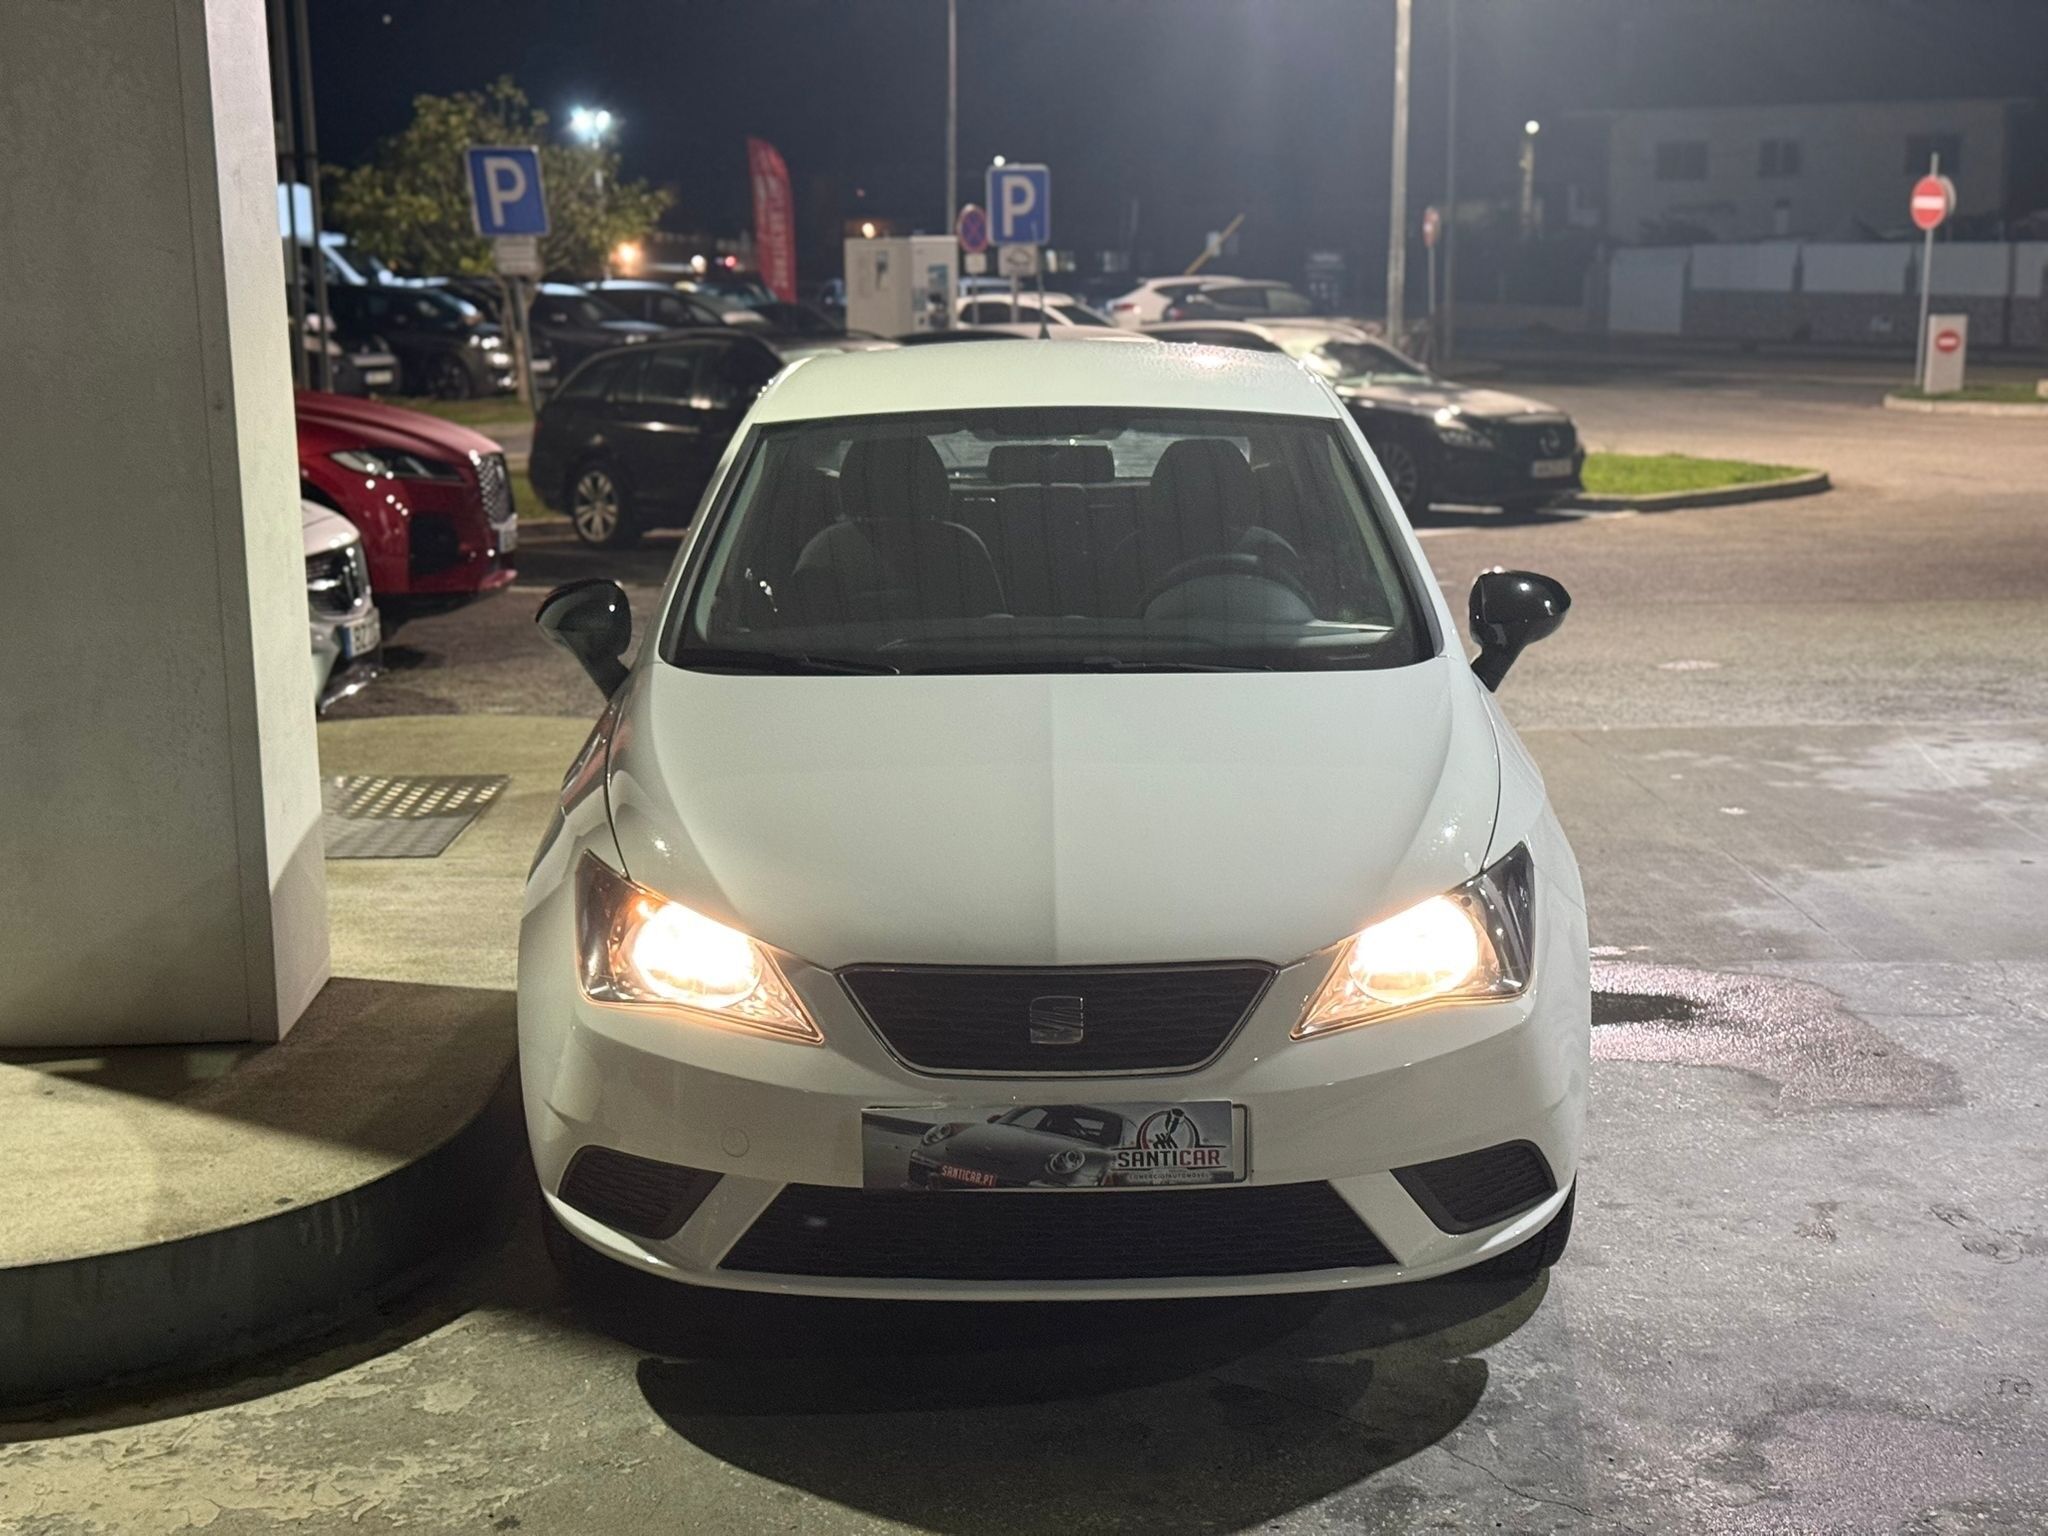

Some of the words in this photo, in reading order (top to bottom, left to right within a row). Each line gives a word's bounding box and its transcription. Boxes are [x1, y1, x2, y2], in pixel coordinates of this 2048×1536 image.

[484, 157, 526, 227] P
[1002, 175, 1036, 237] P
[942, 1165, 993, 1186] SANTICAR.PT
[1118, 1149, 1220, 1167] SANTICAR
